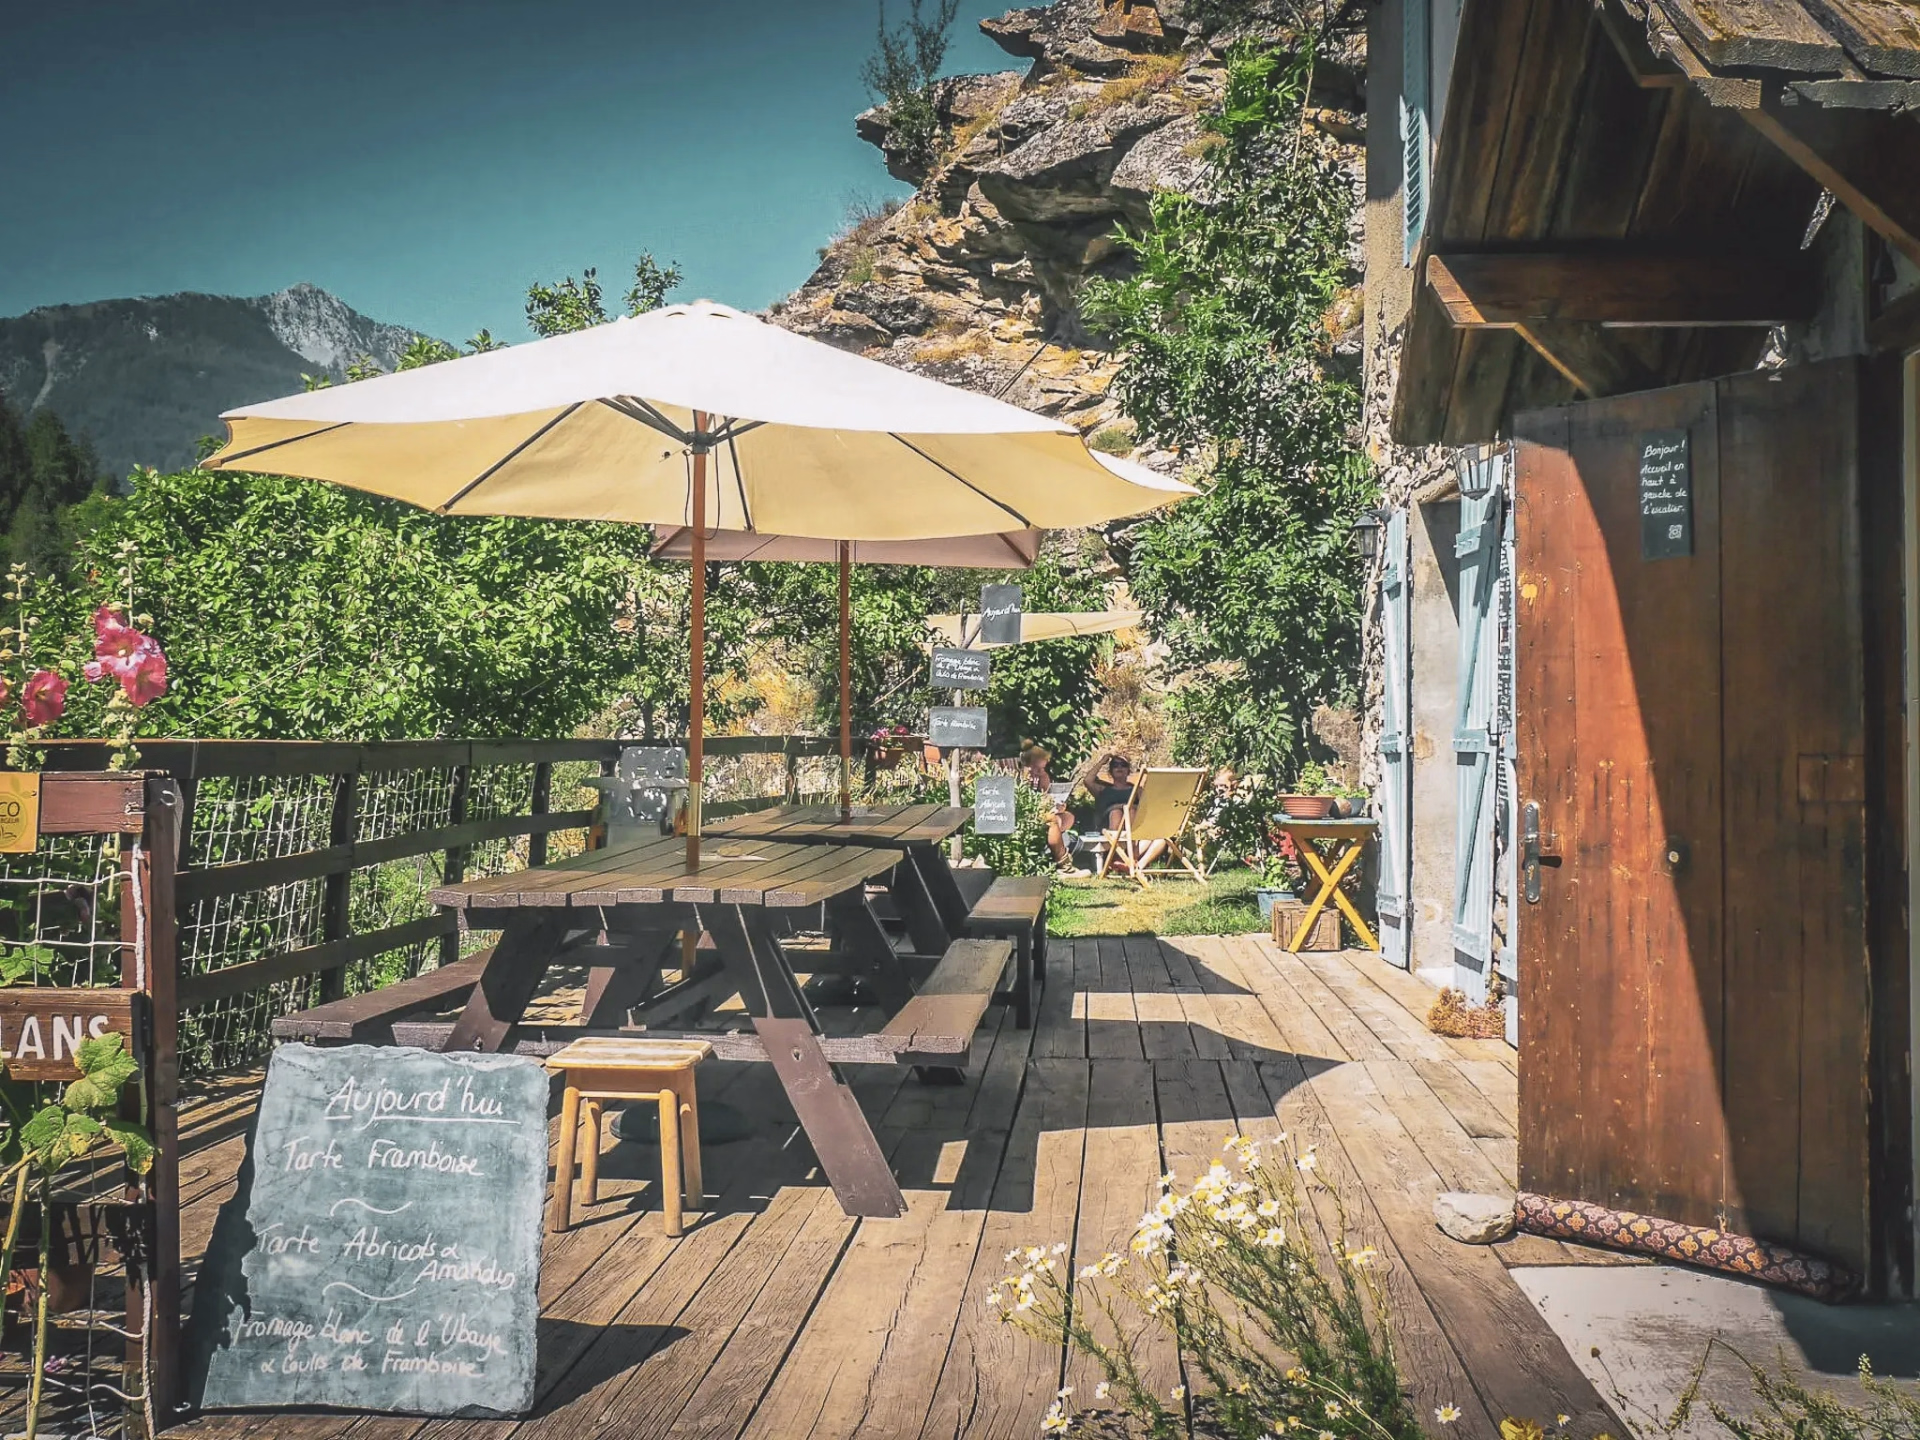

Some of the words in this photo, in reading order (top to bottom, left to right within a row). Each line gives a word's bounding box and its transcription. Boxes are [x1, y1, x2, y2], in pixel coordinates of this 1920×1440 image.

[1640, 462, 1672, 474] Accueil
[1674, 463, 1684, 471] en
[1641, 475, 1663, 487] haut
[1669, 474, 1677, 484] à
[1641, 488, 1672, 503] gauche
[1675, 488, 1687, 497] de
[324, 1075, 503, 1131] Aujourd'hui
[282, 1136, 343, 1172] Tarte
[367, 1138, 485, 1176] Framboise
[255, 1222, 321, 1255] Tarte
[343, 1226, 438, 1261] Abricots
[231, 1310, 316, 1353] Fromage
[318, 1306, 375, 1344] blanc
[385, 1317, 405, 1346] de
[280, 1353, 329, 1375] Coulis
[340, 1348, 369, 1372] de
[380, 1349, 486, 1378] Framboise
